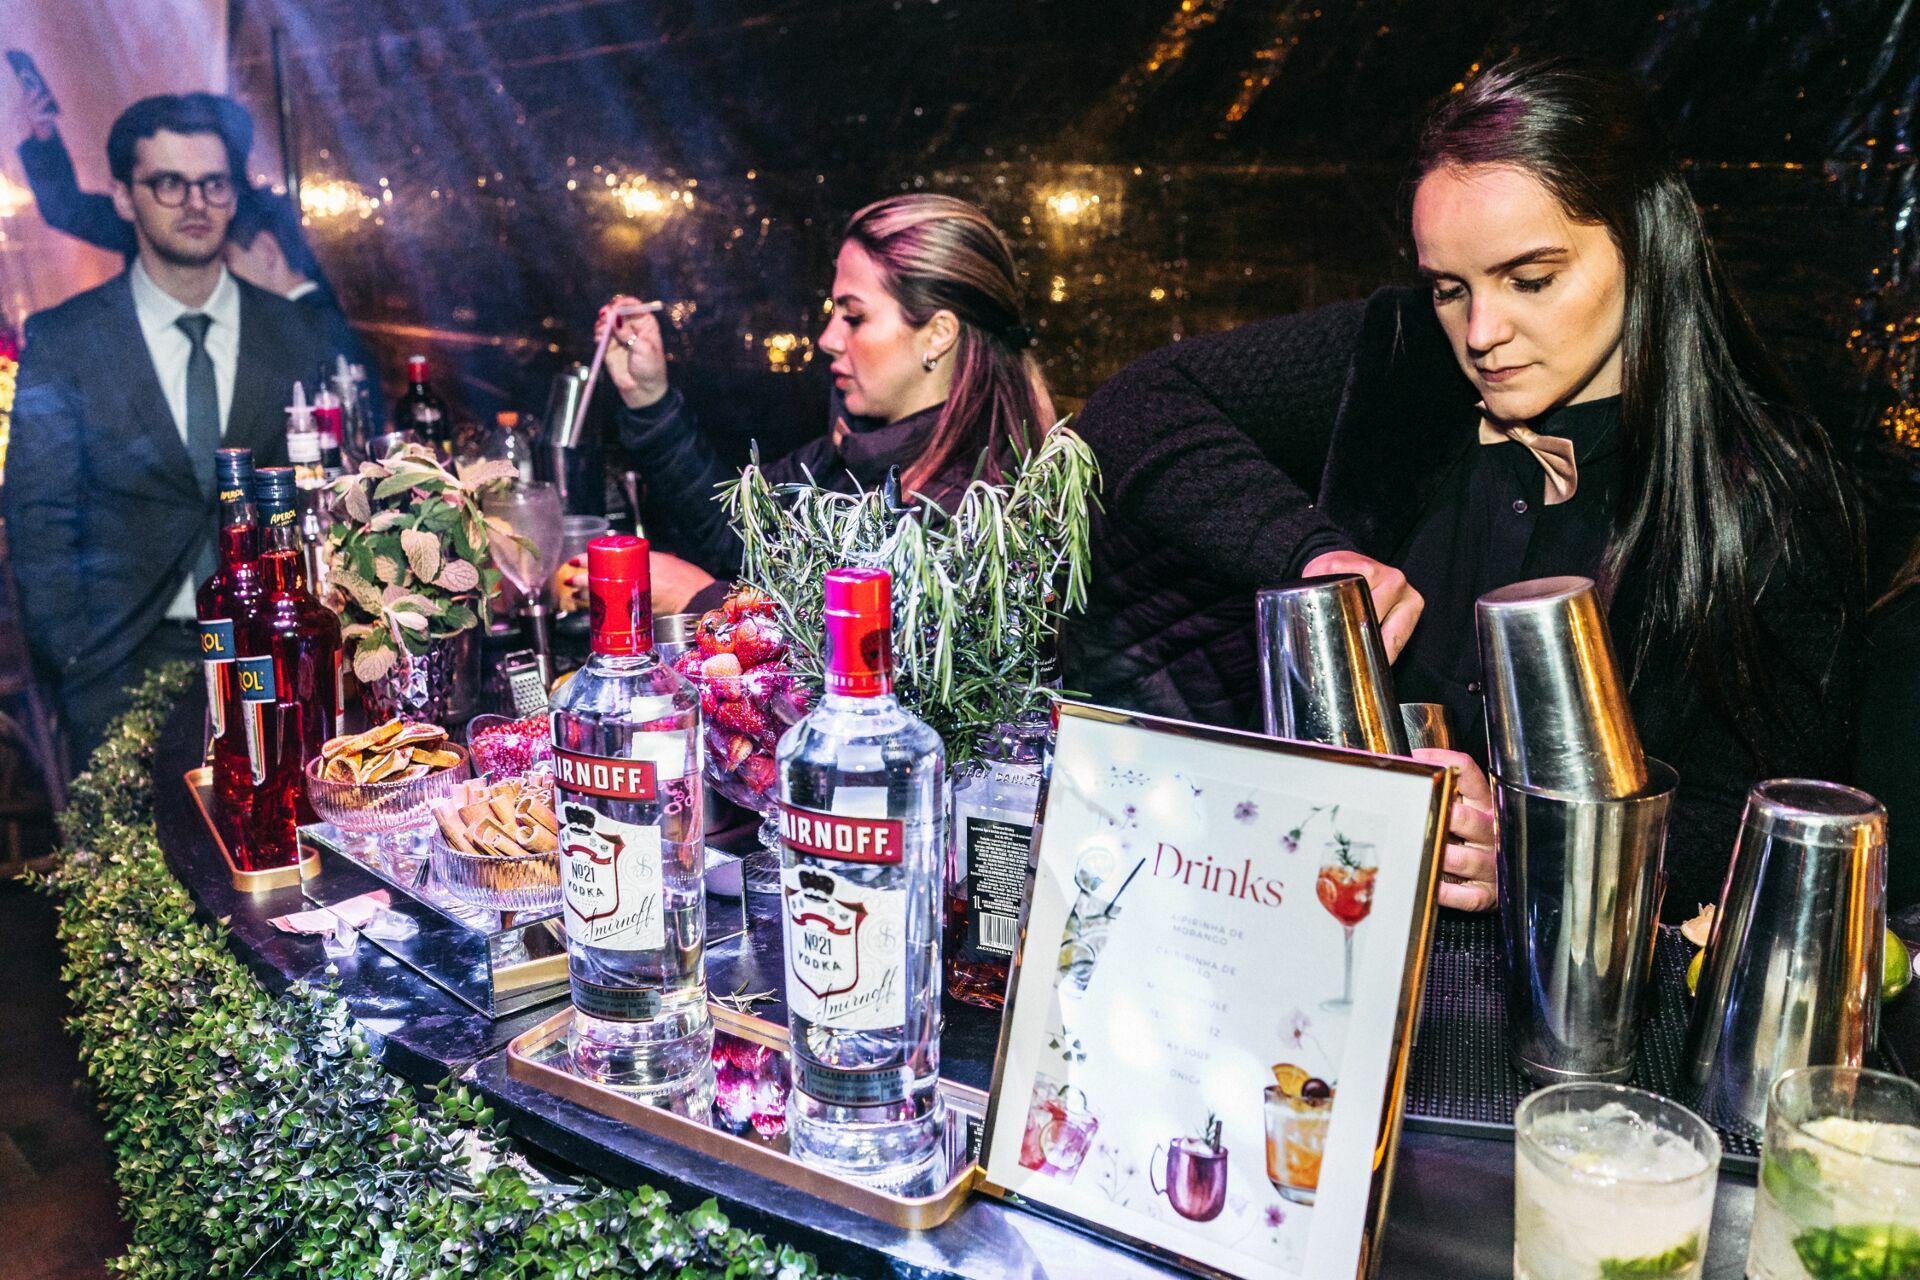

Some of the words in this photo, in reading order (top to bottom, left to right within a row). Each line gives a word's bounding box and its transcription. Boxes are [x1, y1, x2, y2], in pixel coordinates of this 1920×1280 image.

[270, 508, 296, 525] APEROL
[1153, 842, 1284, 908] Drinks
[568, 879, 605, 897] VODKA
[1172, 924, 1228, 946] MORANGO
[1229, 928, 1244, 940] DE
[798, 950, 842, 971] VODKA
